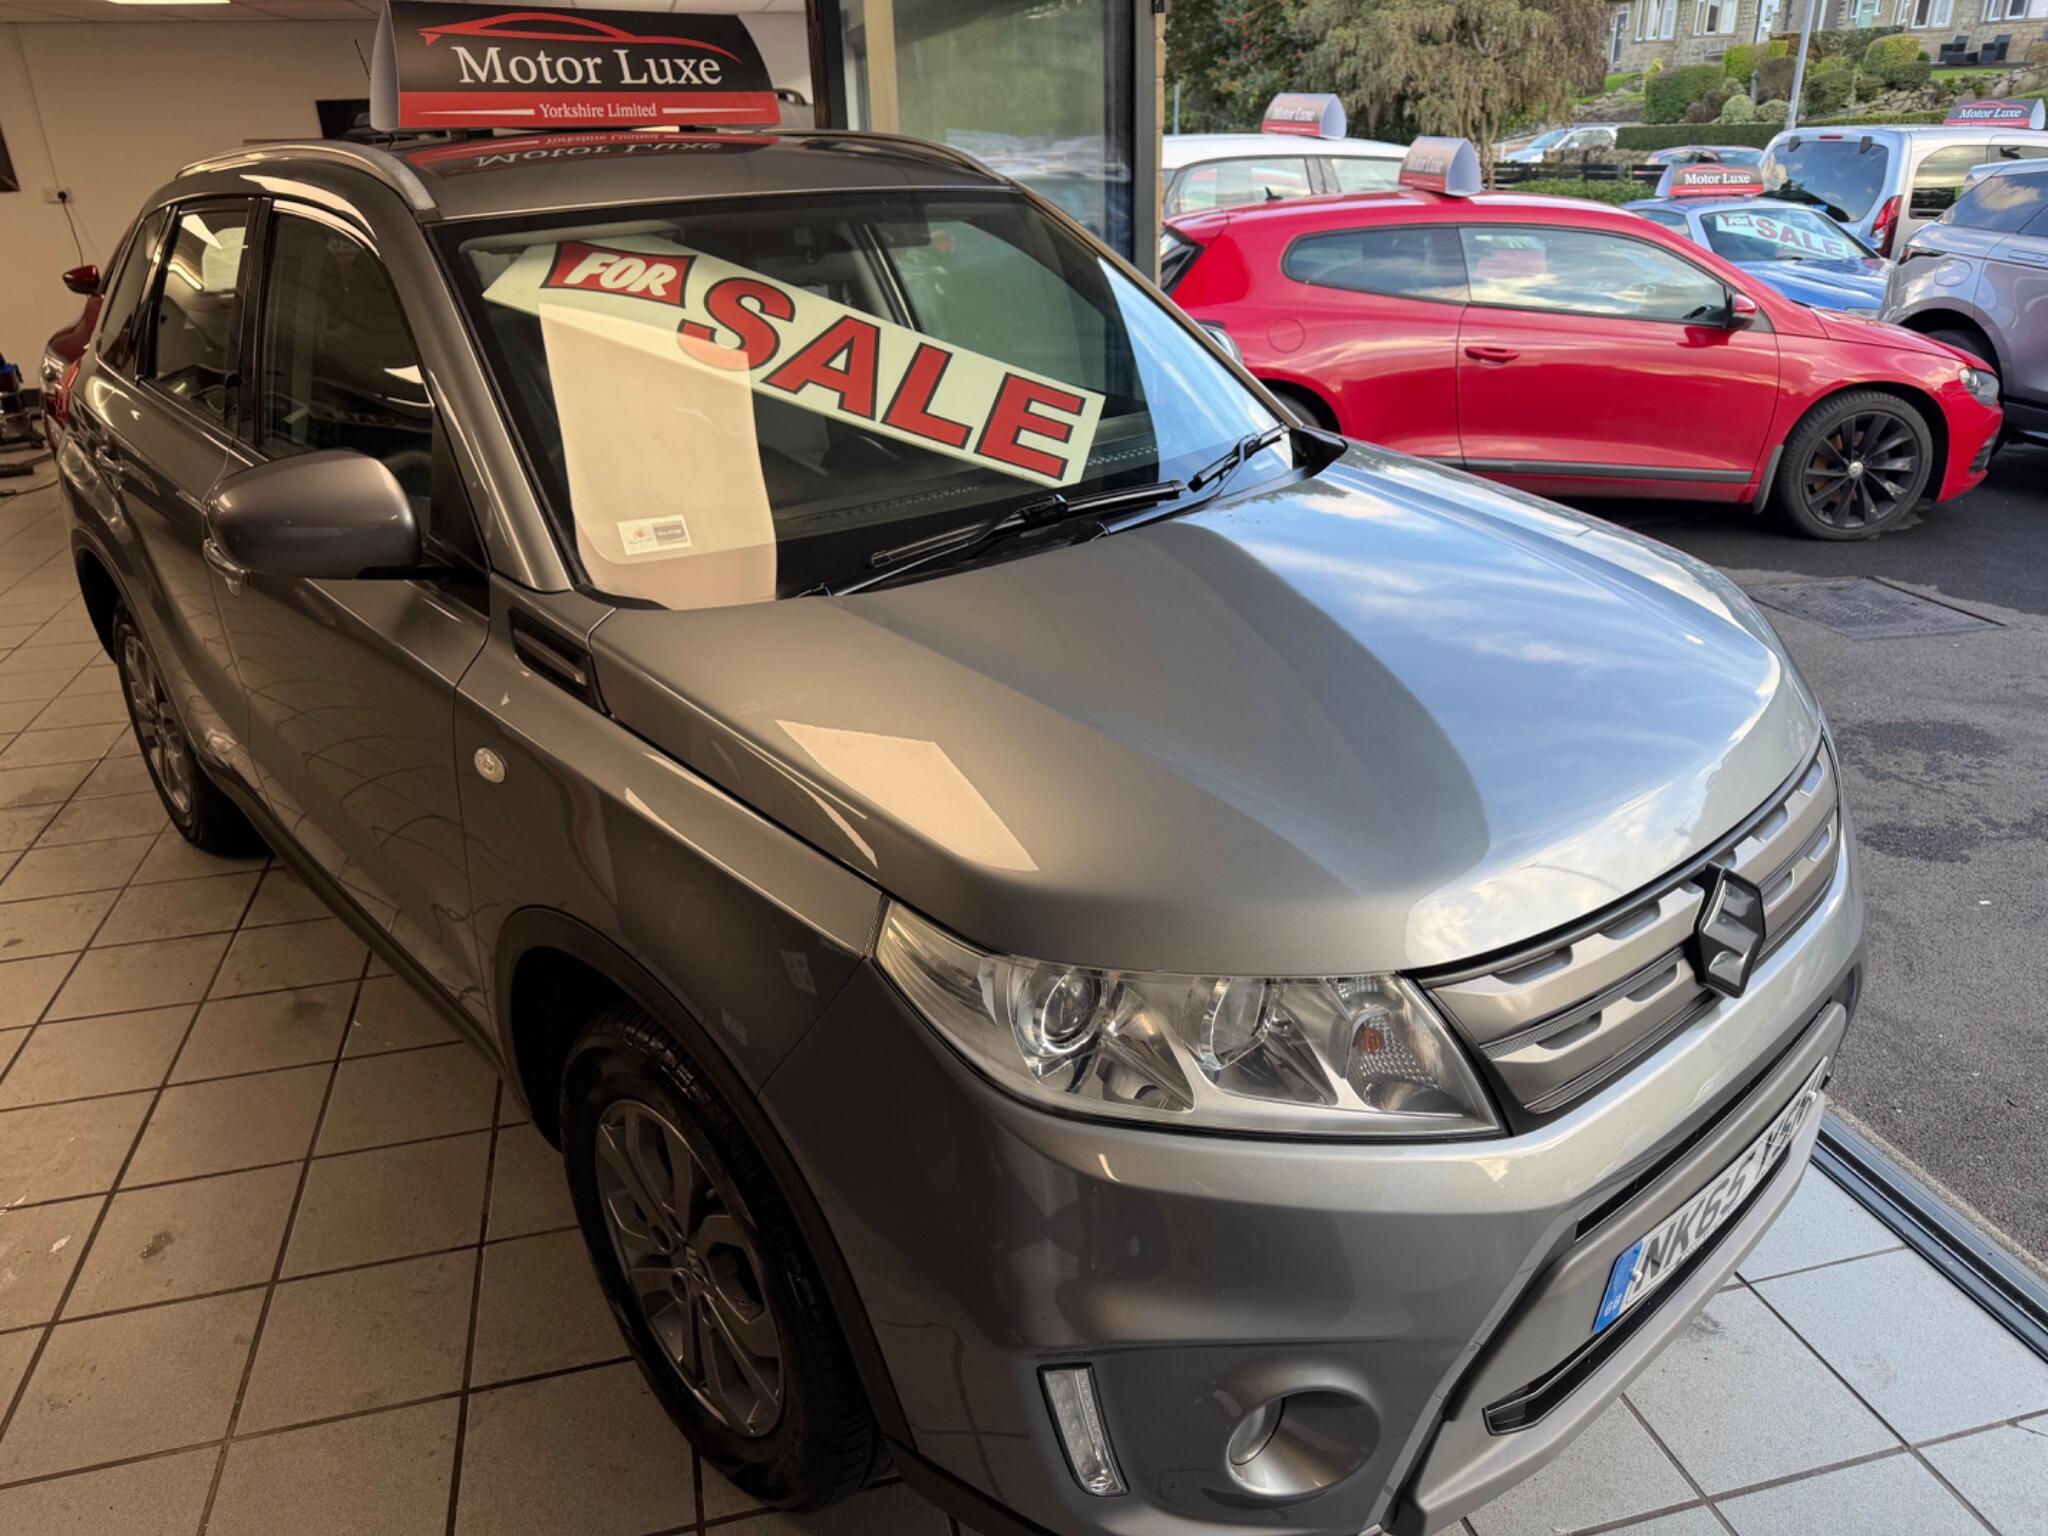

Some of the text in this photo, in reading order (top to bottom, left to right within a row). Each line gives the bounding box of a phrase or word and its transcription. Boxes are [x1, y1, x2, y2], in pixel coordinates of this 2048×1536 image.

[451, 47, 722, 84] Motor Luxe
[539, 103, 657, 118] Yorkshire Limited
[1959, 108, 2021, 118] Motor Luxe
[1684, 173, 1751, 185] Motor Luxe
[1757, 218, 1842, 256] SALE
[564, 253, 1087, 480] FOR SALE
[1633, 1150, 1757, 1293] NK65
